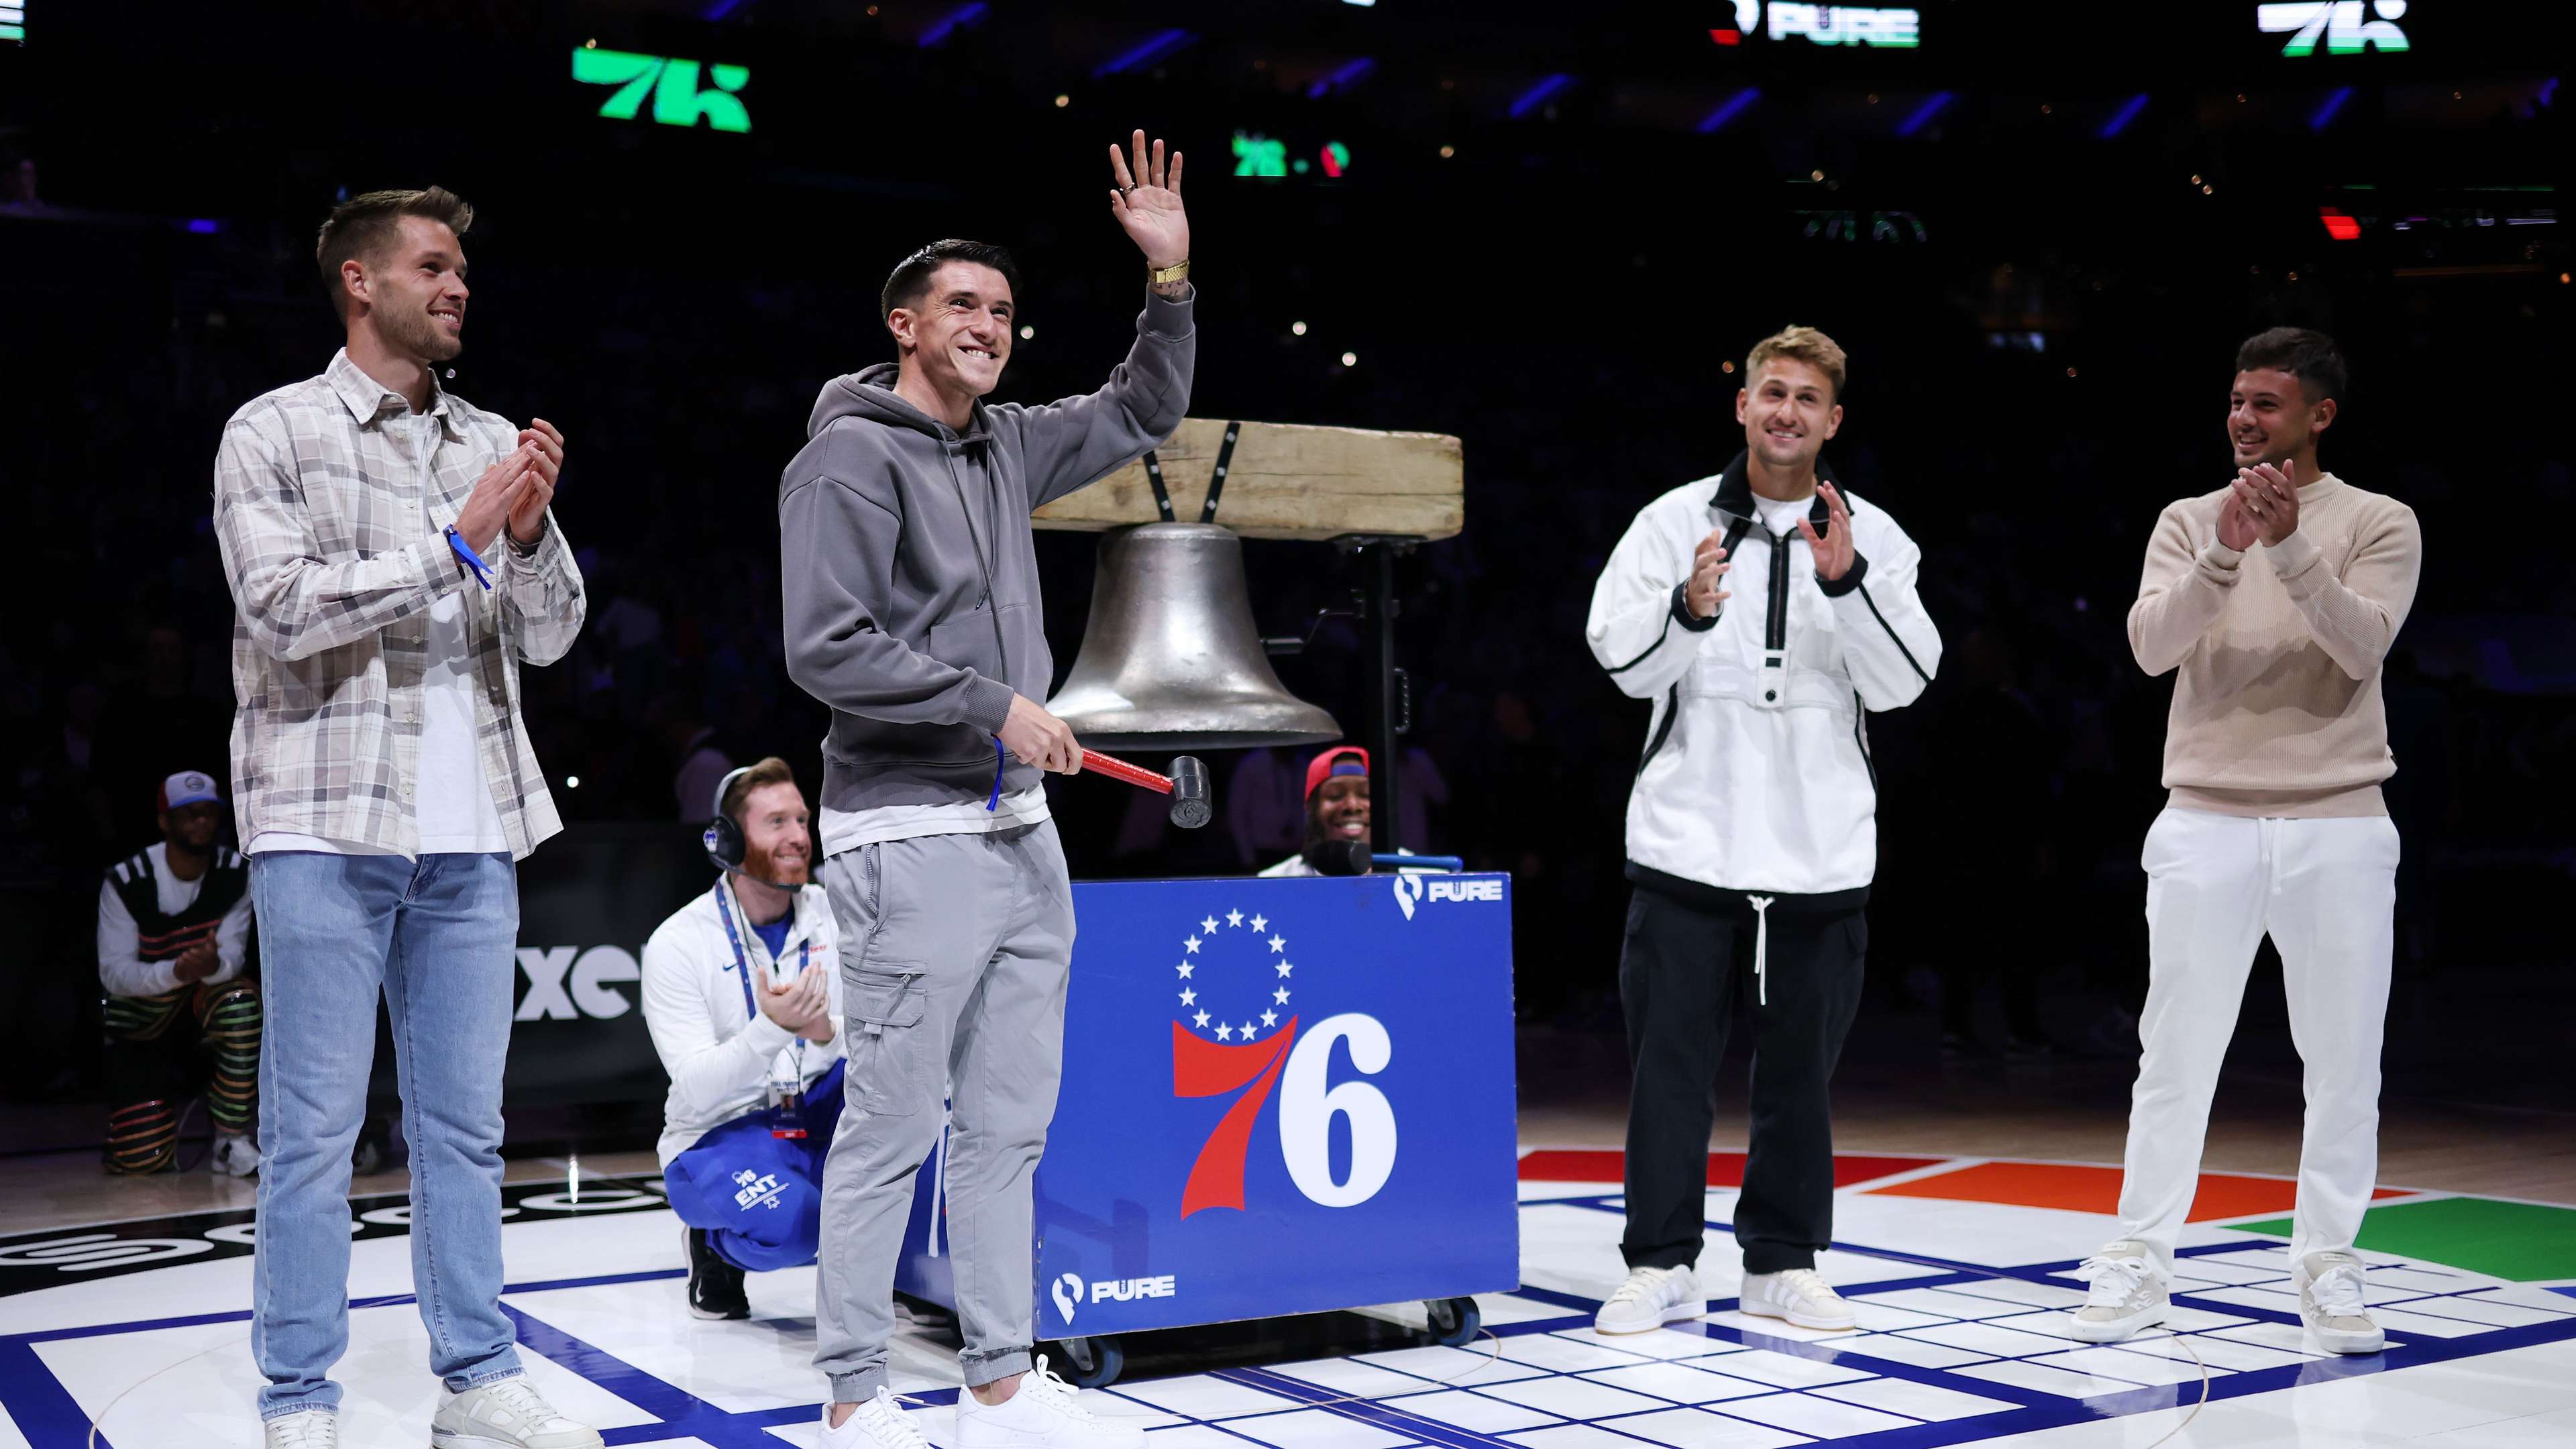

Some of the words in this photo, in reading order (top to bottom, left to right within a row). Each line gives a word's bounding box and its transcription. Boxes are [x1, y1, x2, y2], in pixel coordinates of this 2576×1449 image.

[1768, 1, 1919, 48] PURE
[1428, 880, 1503, 902] PURE
[514, 943, 647, 1021] xe
[1172, 1012, 1397, 1222] 76
[734, 1173, 778, 1207] ENT
[1091, 1275, 1176, 1304] PURE
